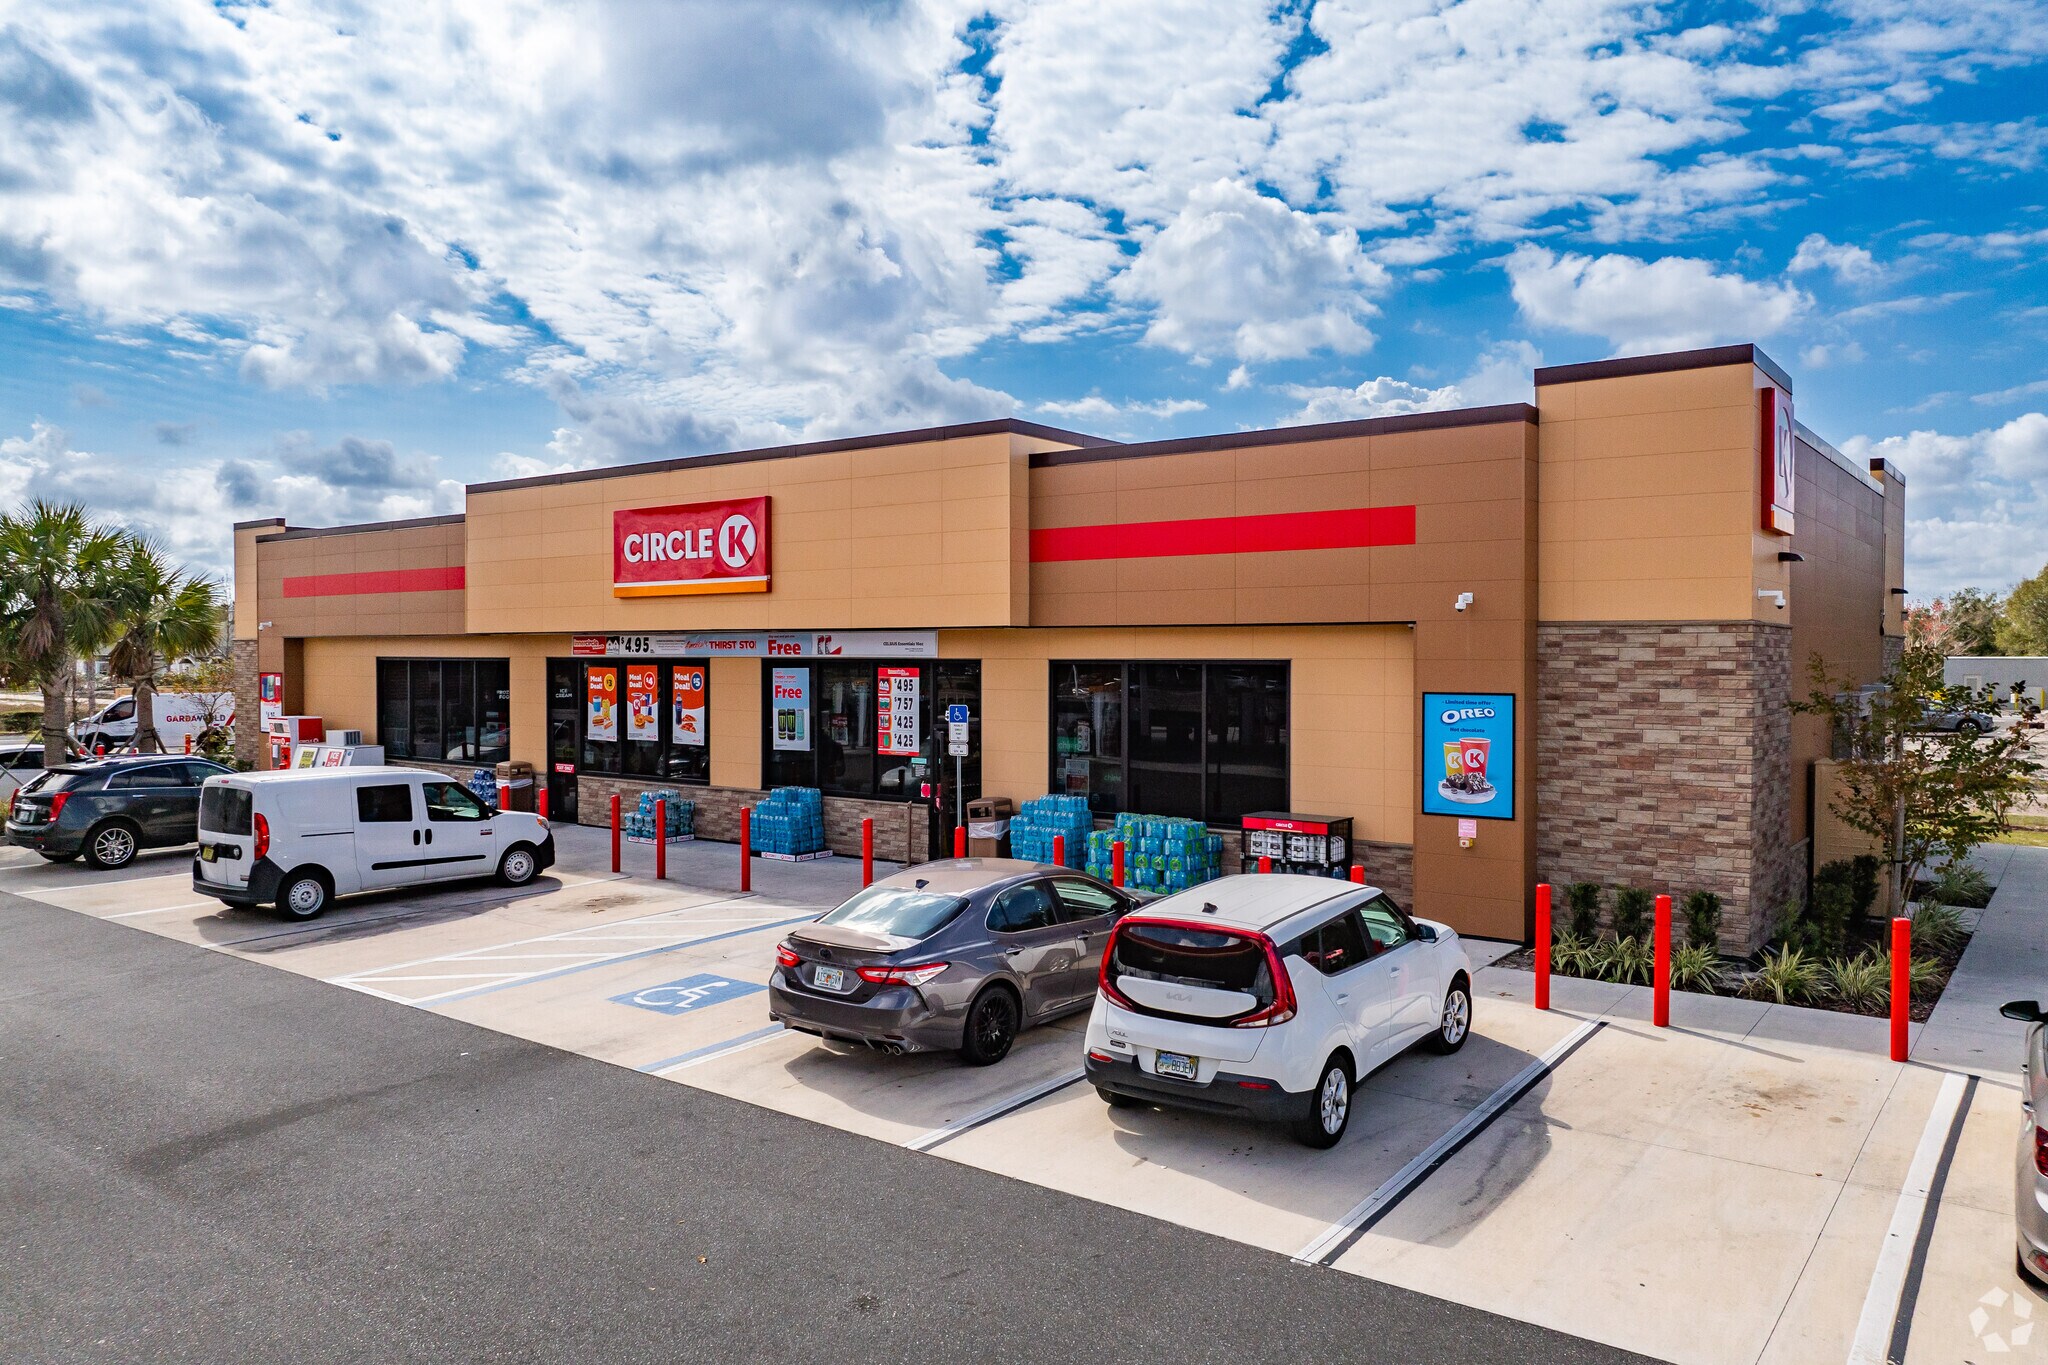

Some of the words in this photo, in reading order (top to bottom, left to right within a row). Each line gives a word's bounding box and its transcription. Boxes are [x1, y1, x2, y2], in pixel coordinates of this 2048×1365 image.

[624, 528, 714, 563] CIRCLE
[728, 525, 753, 565] K
[621, 636, 650, 653] $4.95
[709, 641, 737, 649] THIRST
[739, 640, 757, 649] STO
[768, 640, 801, 655] Free
[675, 673, 690, 681] Meal
[693, 678, 701, 687] $5
[674, 682, 691, 690] Deal!
[774, 685, 802, 699] Free
[166, 714, 226, 722] GARDAWLD
[1441, 708, 1495, 724] OREO
